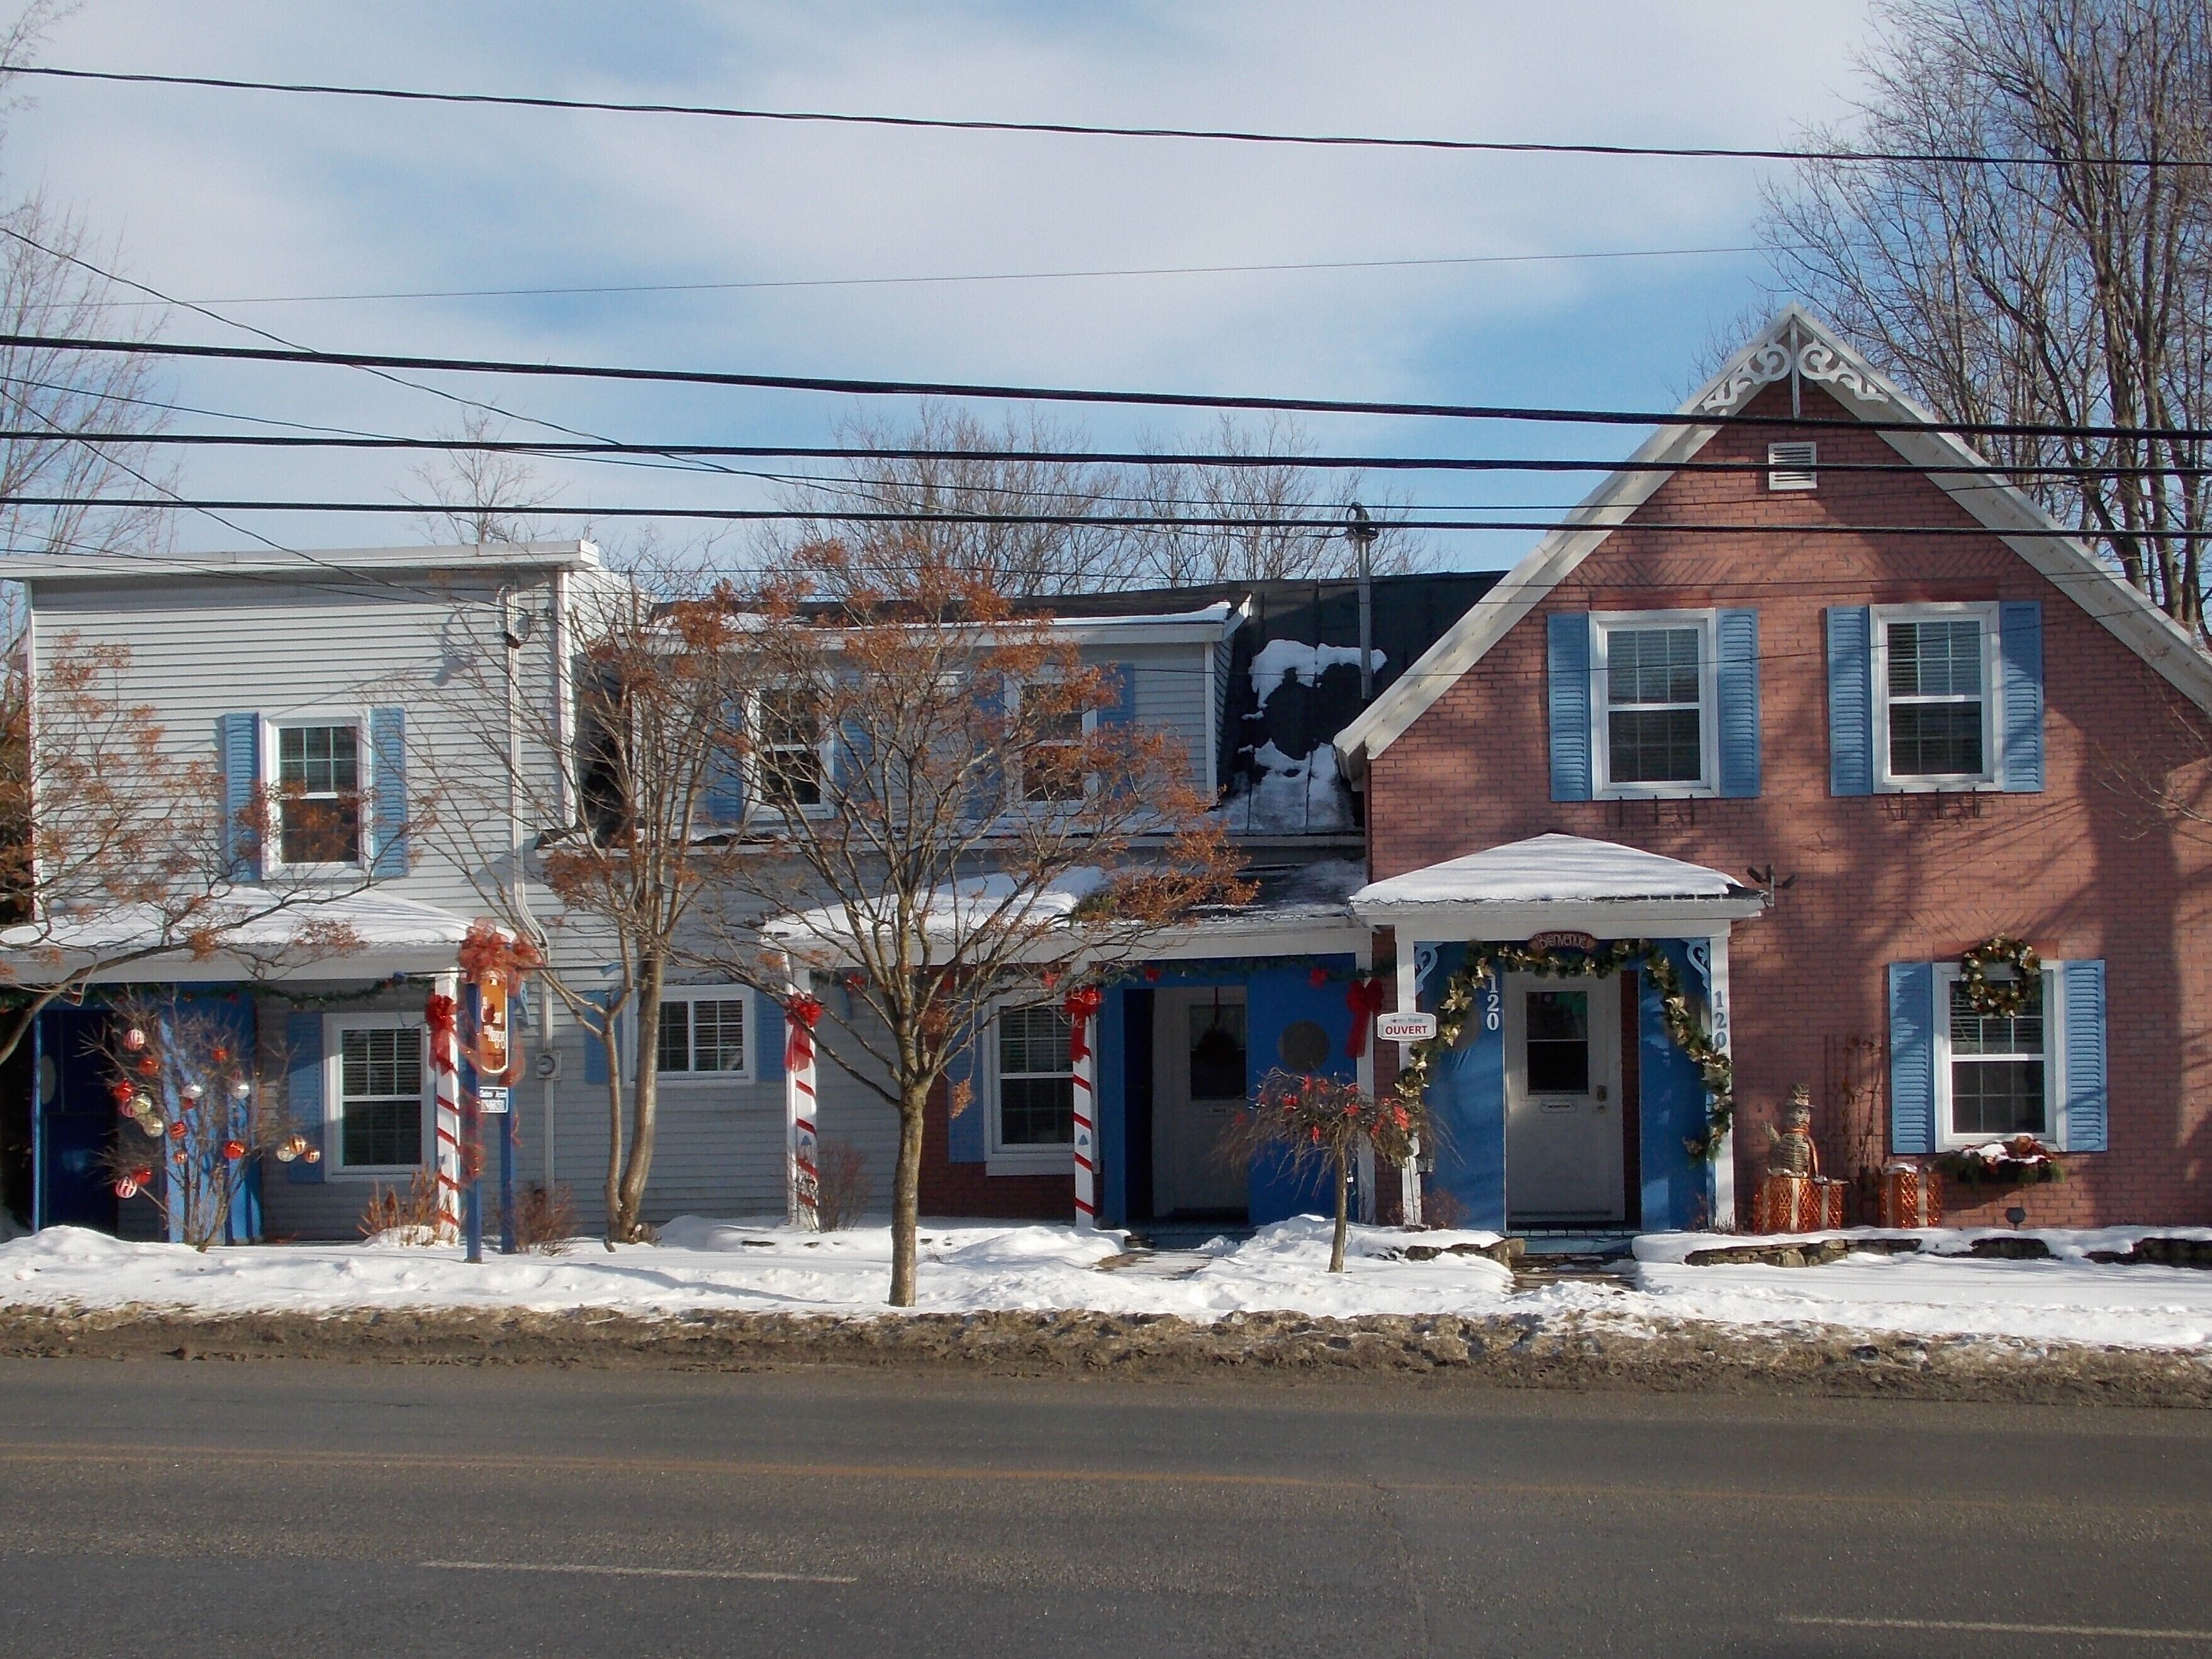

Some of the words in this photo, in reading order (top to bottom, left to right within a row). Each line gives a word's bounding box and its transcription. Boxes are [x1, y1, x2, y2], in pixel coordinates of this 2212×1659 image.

[1385, 1025, 1427, 1035] OUVERT
[1487, 974, 1500, 1031] 120
[1713, 990, 1727, 1048] 120
